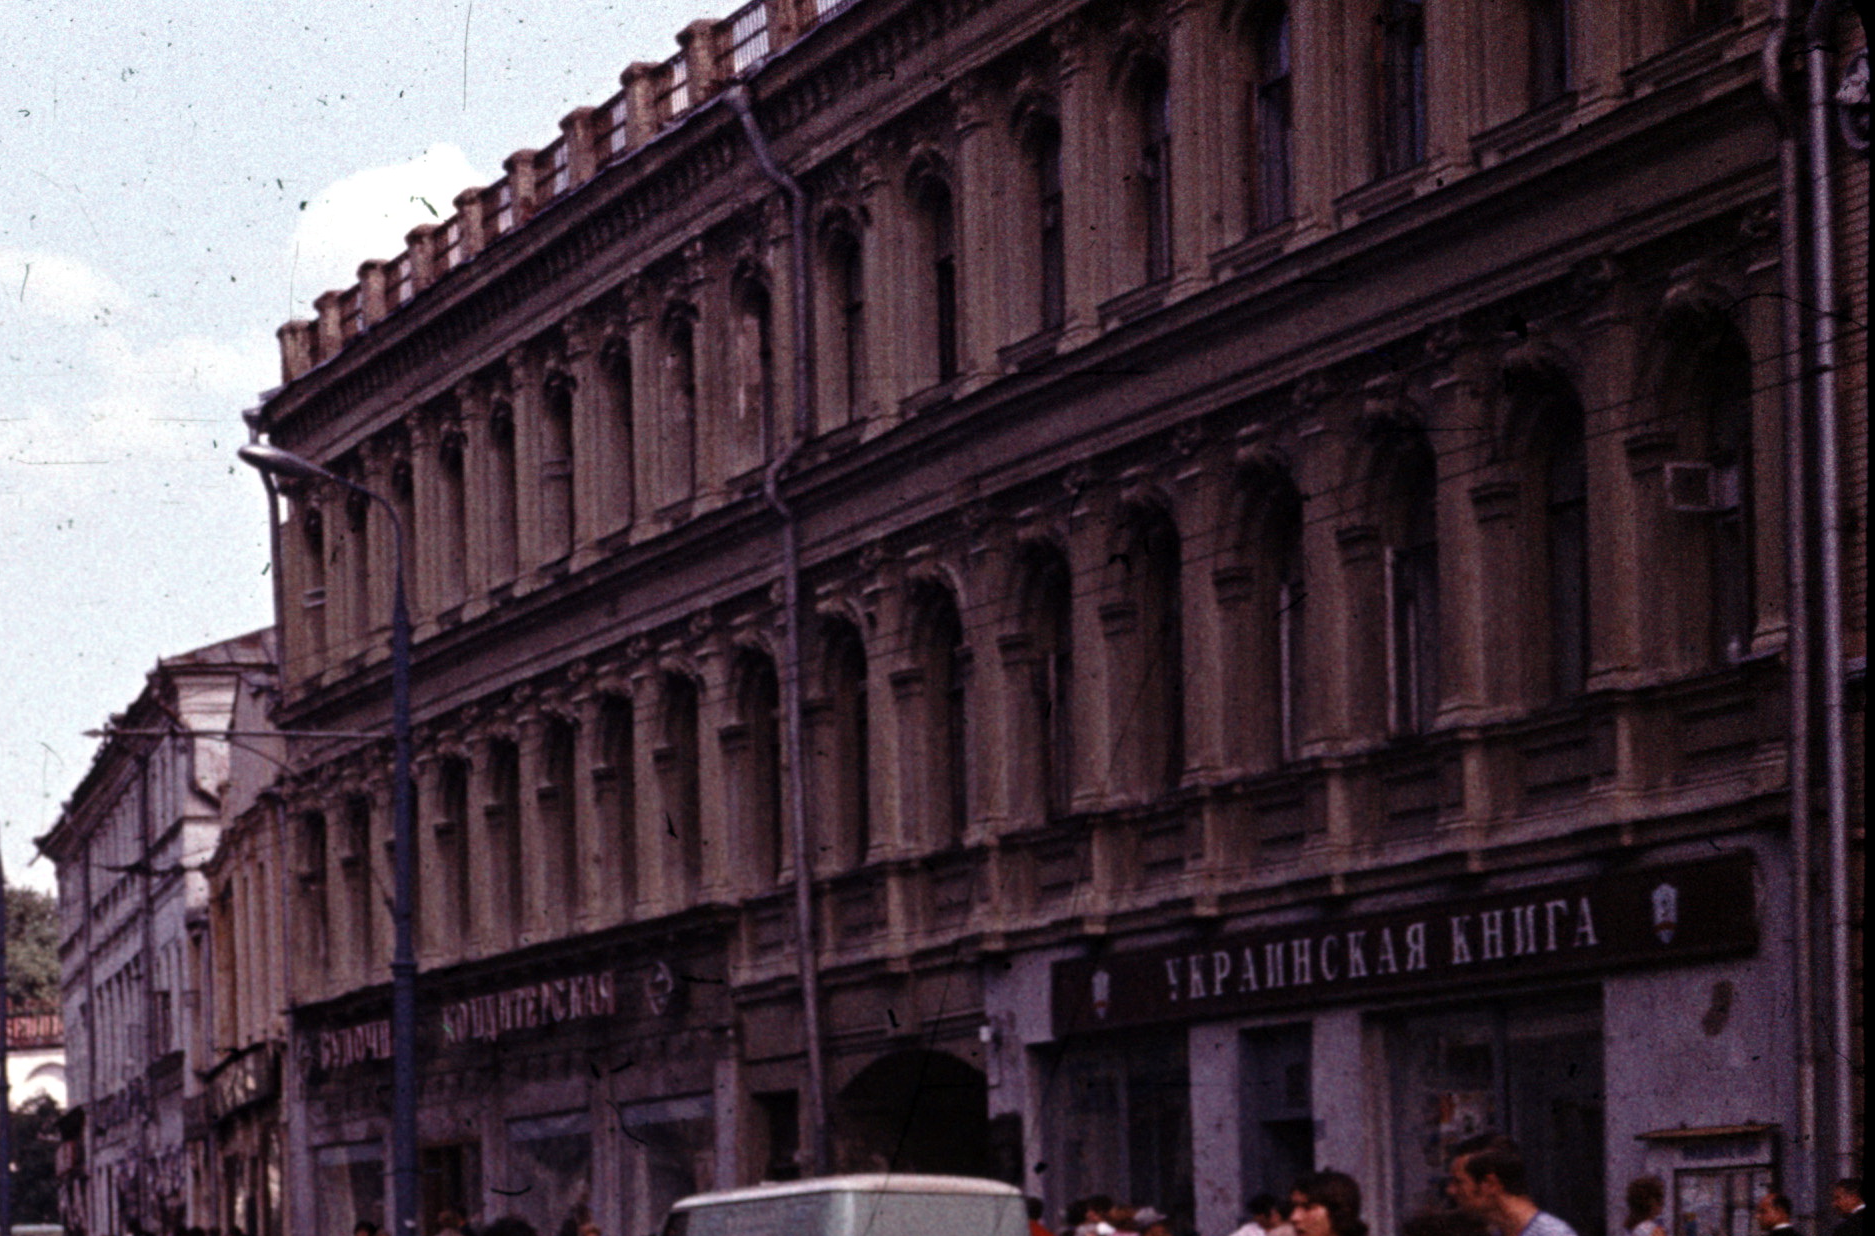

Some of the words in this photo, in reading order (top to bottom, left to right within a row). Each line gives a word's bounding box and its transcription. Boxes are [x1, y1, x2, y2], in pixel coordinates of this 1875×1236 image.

[1164, 921, 1429, 1002] УКРАИНСКАЯ
[1449, 896, 1600, 966] КНИГА
[319, 1019, 394, 1071] БУЛОЧН
